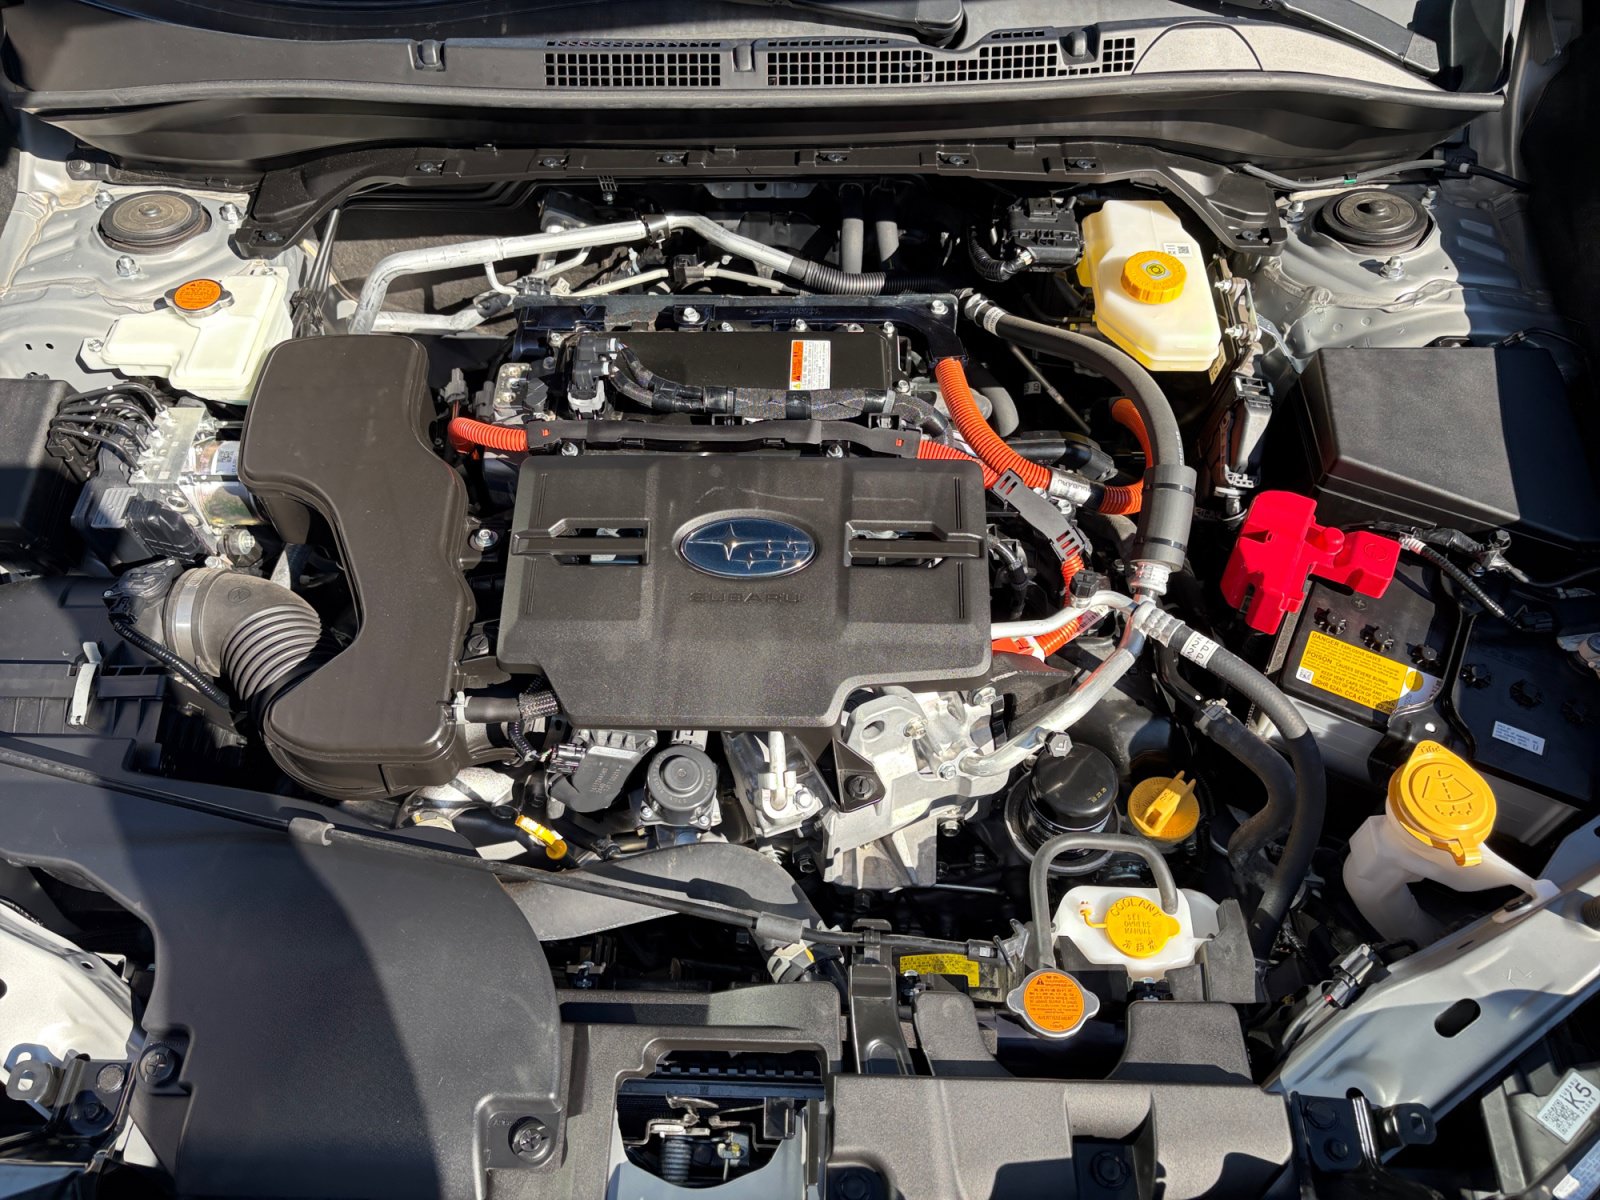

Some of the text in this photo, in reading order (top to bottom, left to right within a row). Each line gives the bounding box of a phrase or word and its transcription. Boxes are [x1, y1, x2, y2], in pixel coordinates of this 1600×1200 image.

[689, 592, 800, 602] SUBARU
[1312, 633, 1339, 647] DANGER
[1306, 650, 1332, 664] POISON
[1110, 898, 1162, 917] COOLANT
[1563, 1080, 1593, 1110] K5
